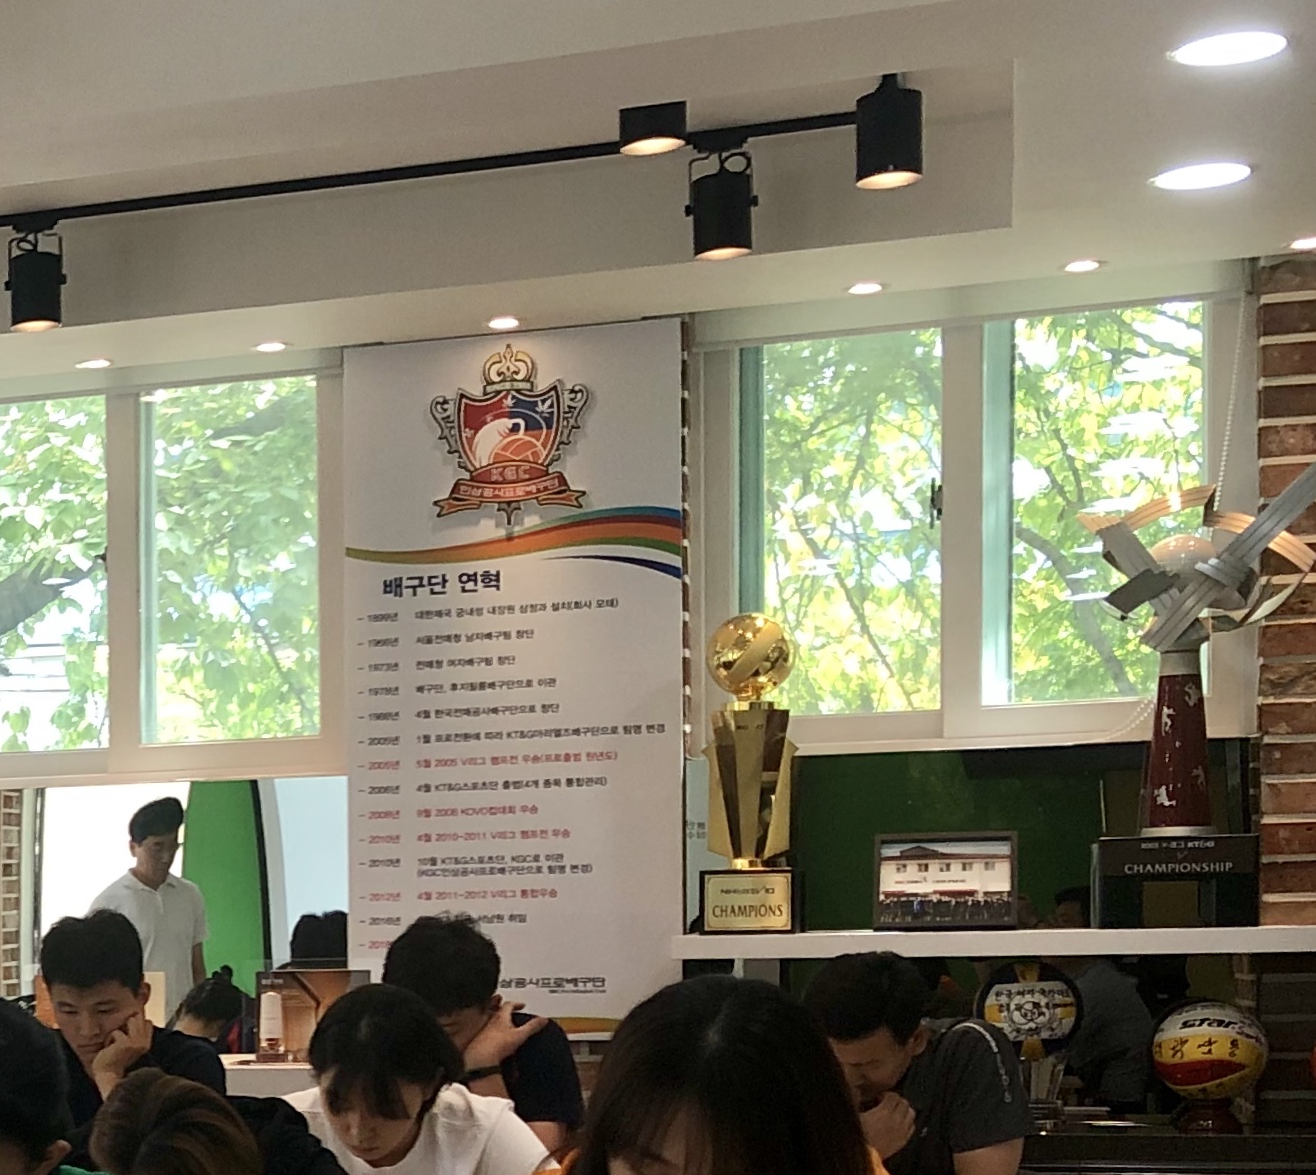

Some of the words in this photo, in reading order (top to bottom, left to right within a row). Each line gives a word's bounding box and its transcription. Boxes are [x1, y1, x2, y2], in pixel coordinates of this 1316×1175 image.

[383, 574, 448, 597] 배구단
[458, 570, 501, 594] 연혁
[646, 723, 666, 734] 변경
[519, 805, 539, 814] 우승
[552, 829, 570, 838] 우승
[1124, 862, 1233, 875] CHAMPIONSHIP
[712, 904, 783, 919] CHAMPIONS
